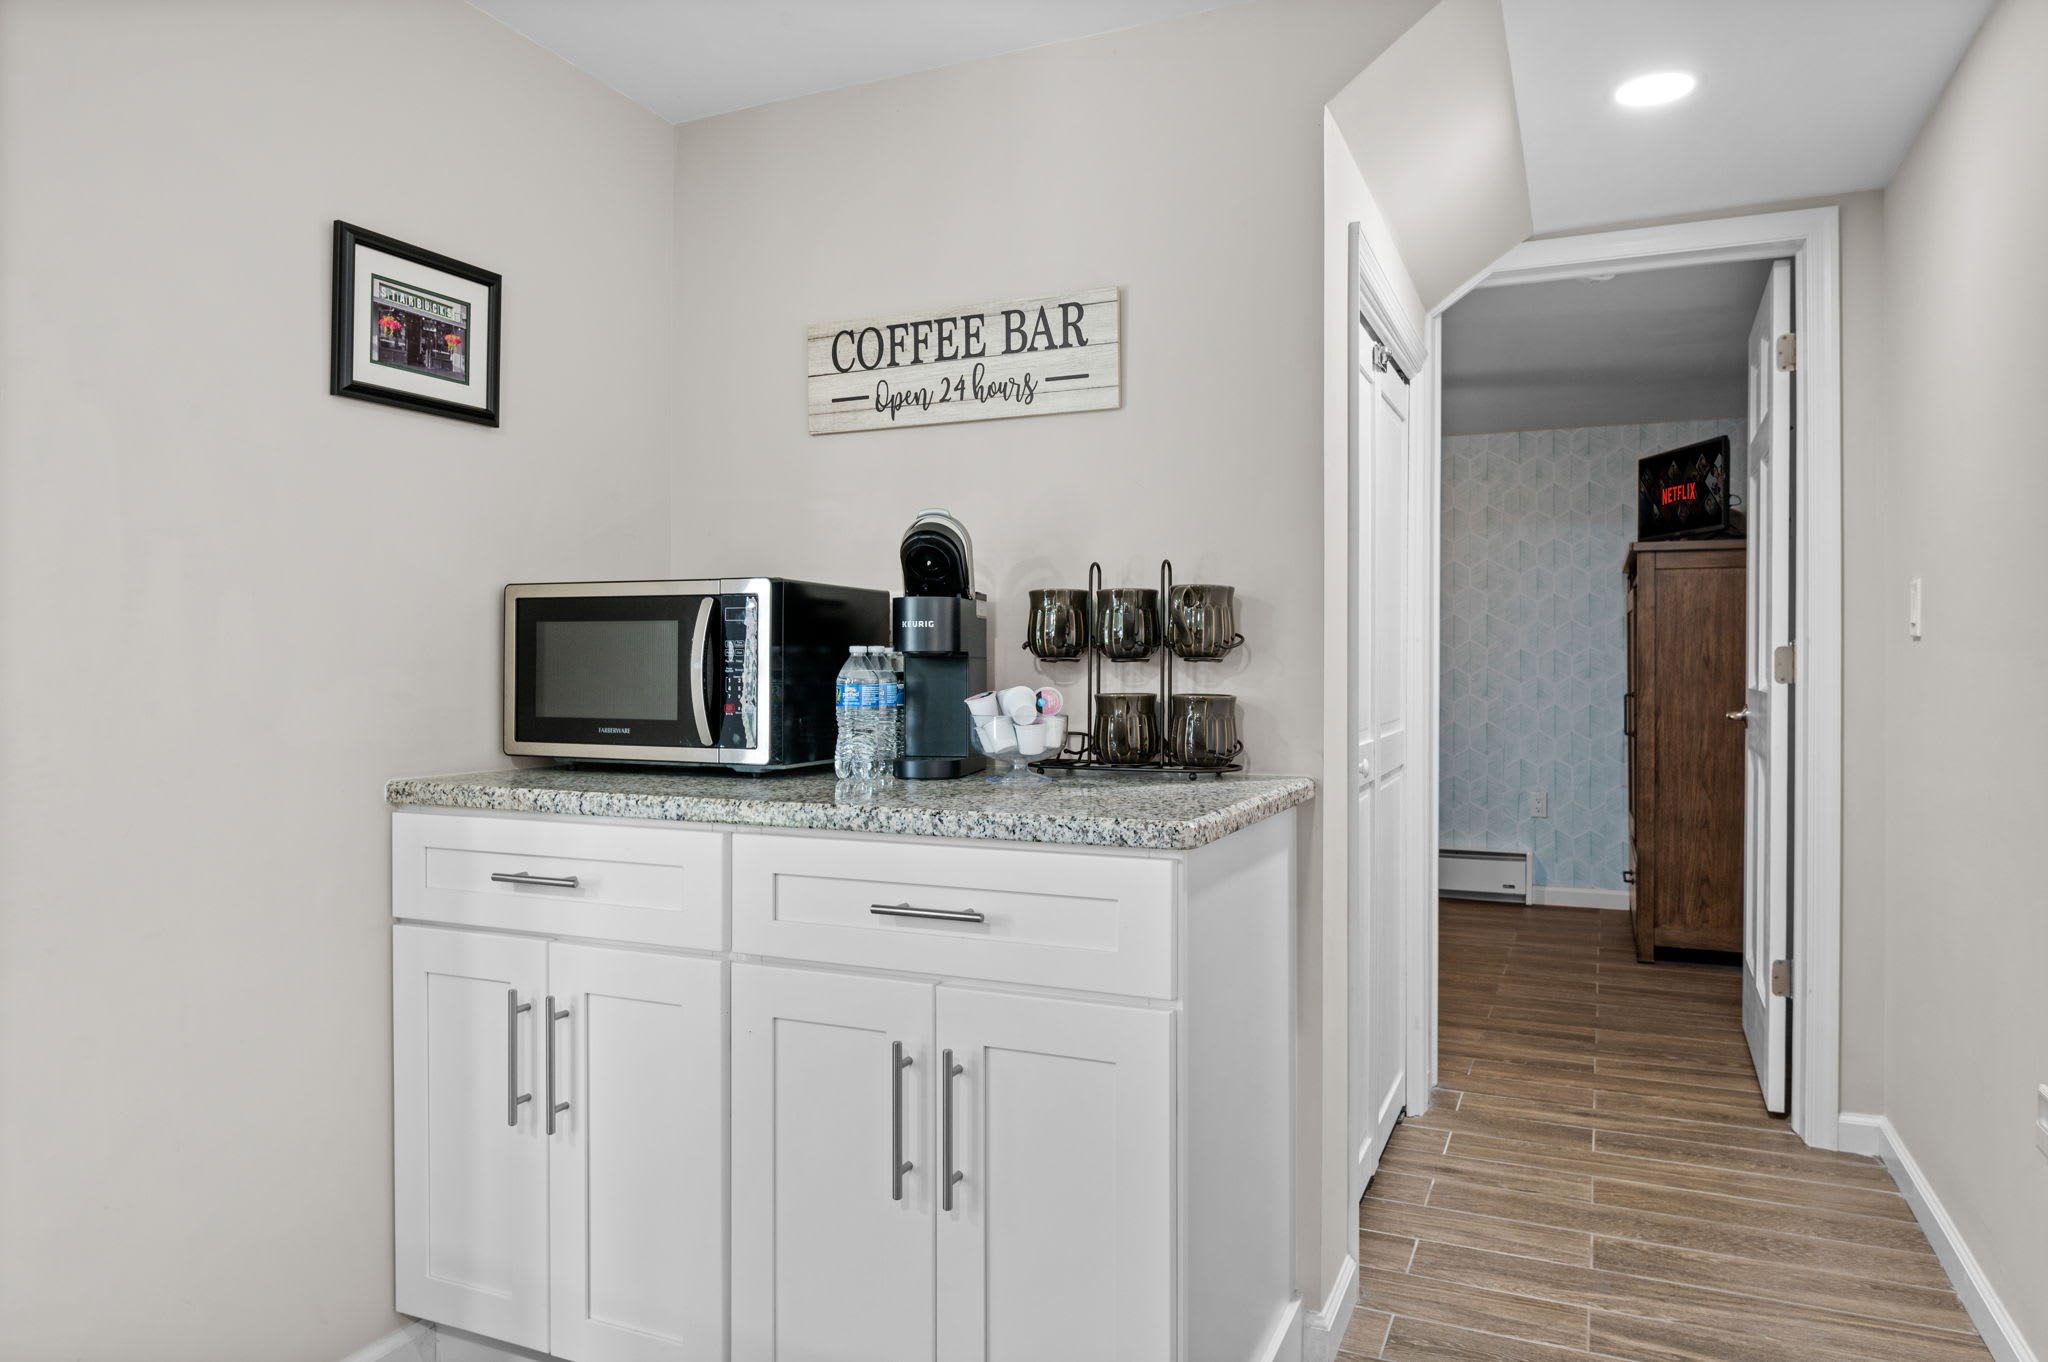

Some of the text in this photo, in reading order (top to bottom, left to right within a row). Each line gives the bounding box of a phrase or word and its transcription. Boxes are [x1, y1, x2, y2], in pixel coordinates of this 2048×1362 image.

[381, 286, 453, 319] STARBUCKS
[831, 301, 1089, 374] COFFEE BAR
[875, 362, 1038, 421] Open 24 hours
[1661, 482, 1697, 506] NETFLIX
[901, 620, 935, 628] KEURIG
[598, 727, 631, 735] FARBERWARE
